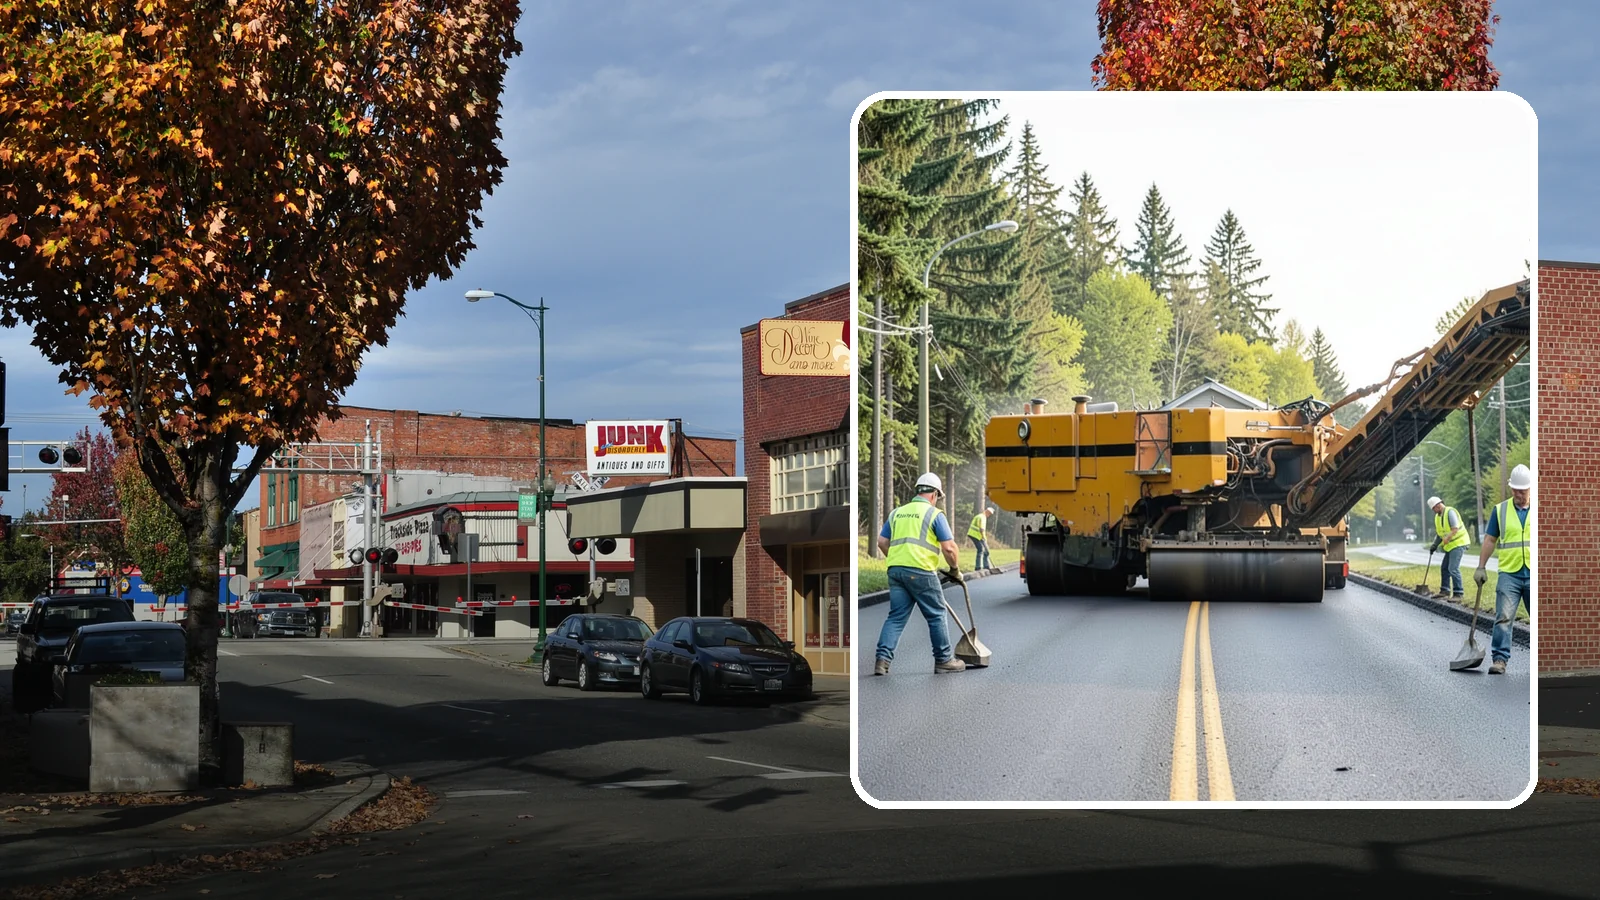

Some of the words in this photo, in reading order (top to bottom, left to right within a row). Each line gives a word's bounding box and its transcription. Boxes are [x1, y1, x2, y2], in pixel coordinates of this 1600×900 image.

[595, 425, 665, 457] JUNK
[607, 446, 646, 454] DISORDERLY
[596, 461, 628, 470] ANTIQUES
[631, 461, 644, 470] AND
[647, 460, 665, 469] GIFTS
